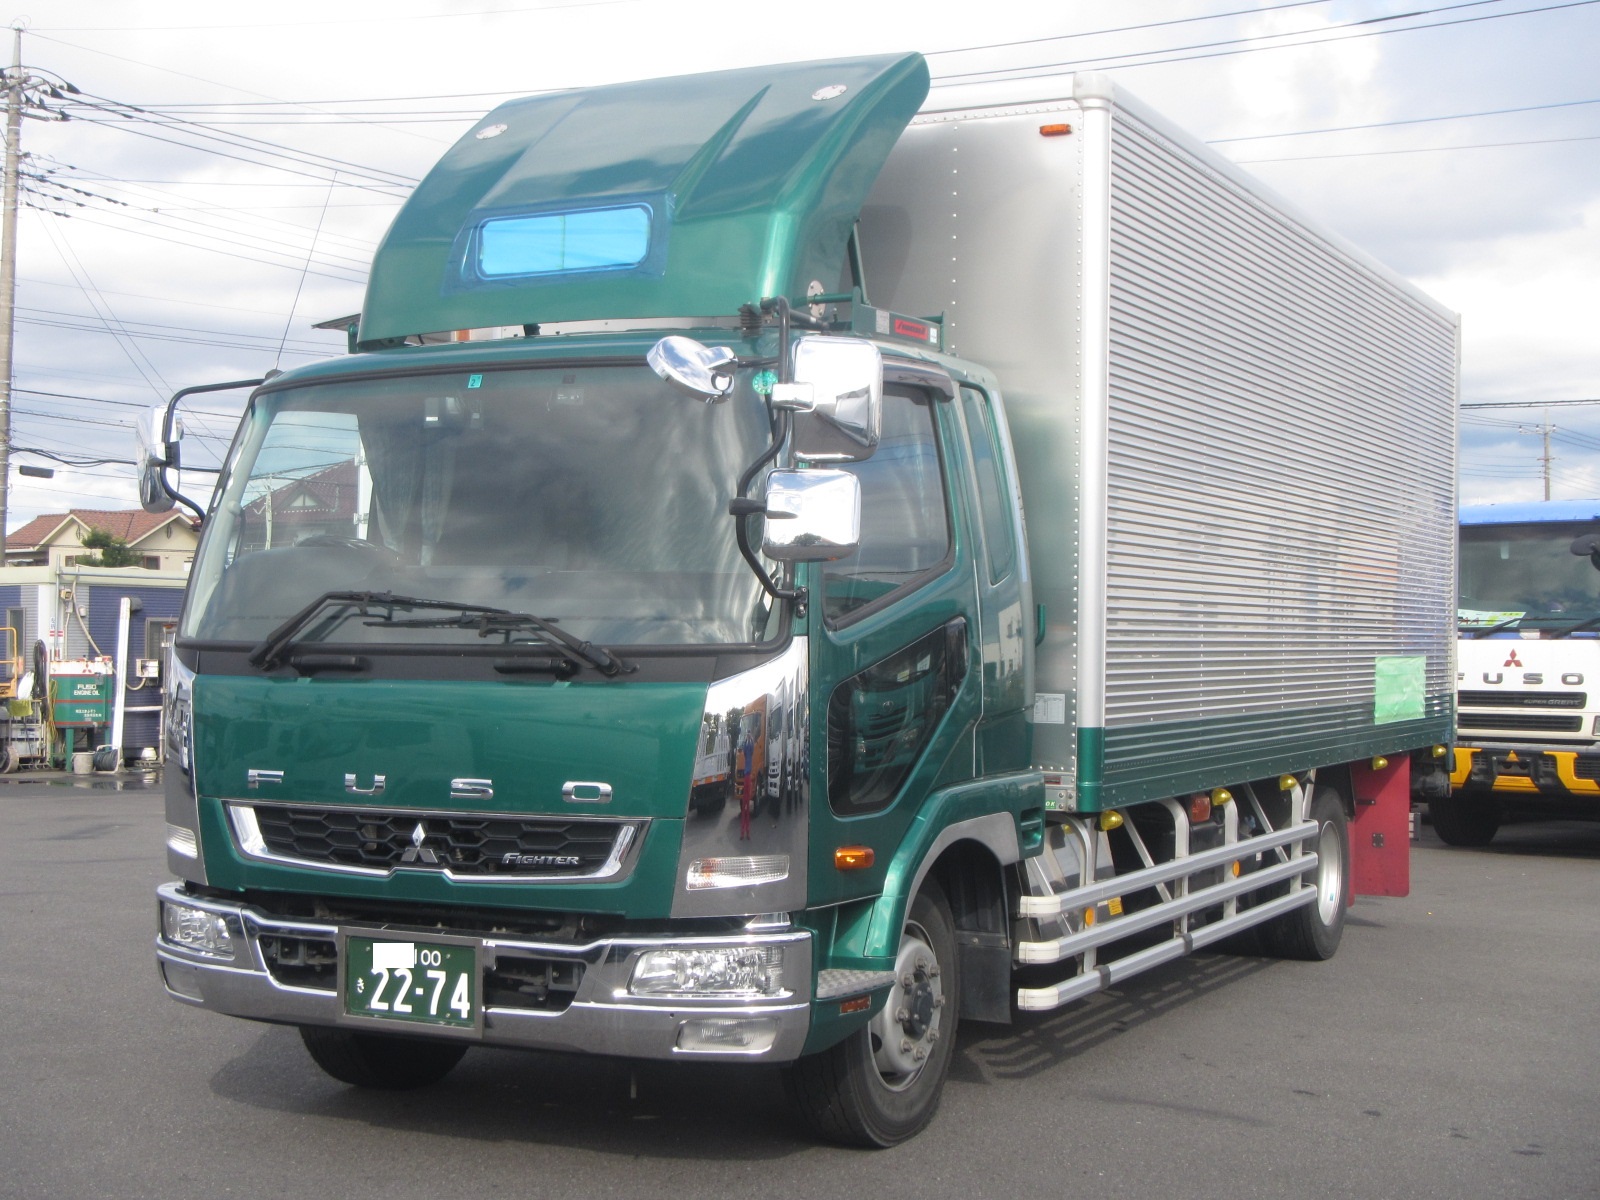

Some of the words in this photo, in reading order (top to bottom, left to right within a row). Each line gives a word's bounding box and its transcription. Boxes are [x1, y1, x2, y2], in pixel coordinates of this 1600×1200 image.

[248, 769, 613, 803] FUSO
[501, 852, 580, 866] FIGHTER
[370, 967, 471, 1019] 22-74
